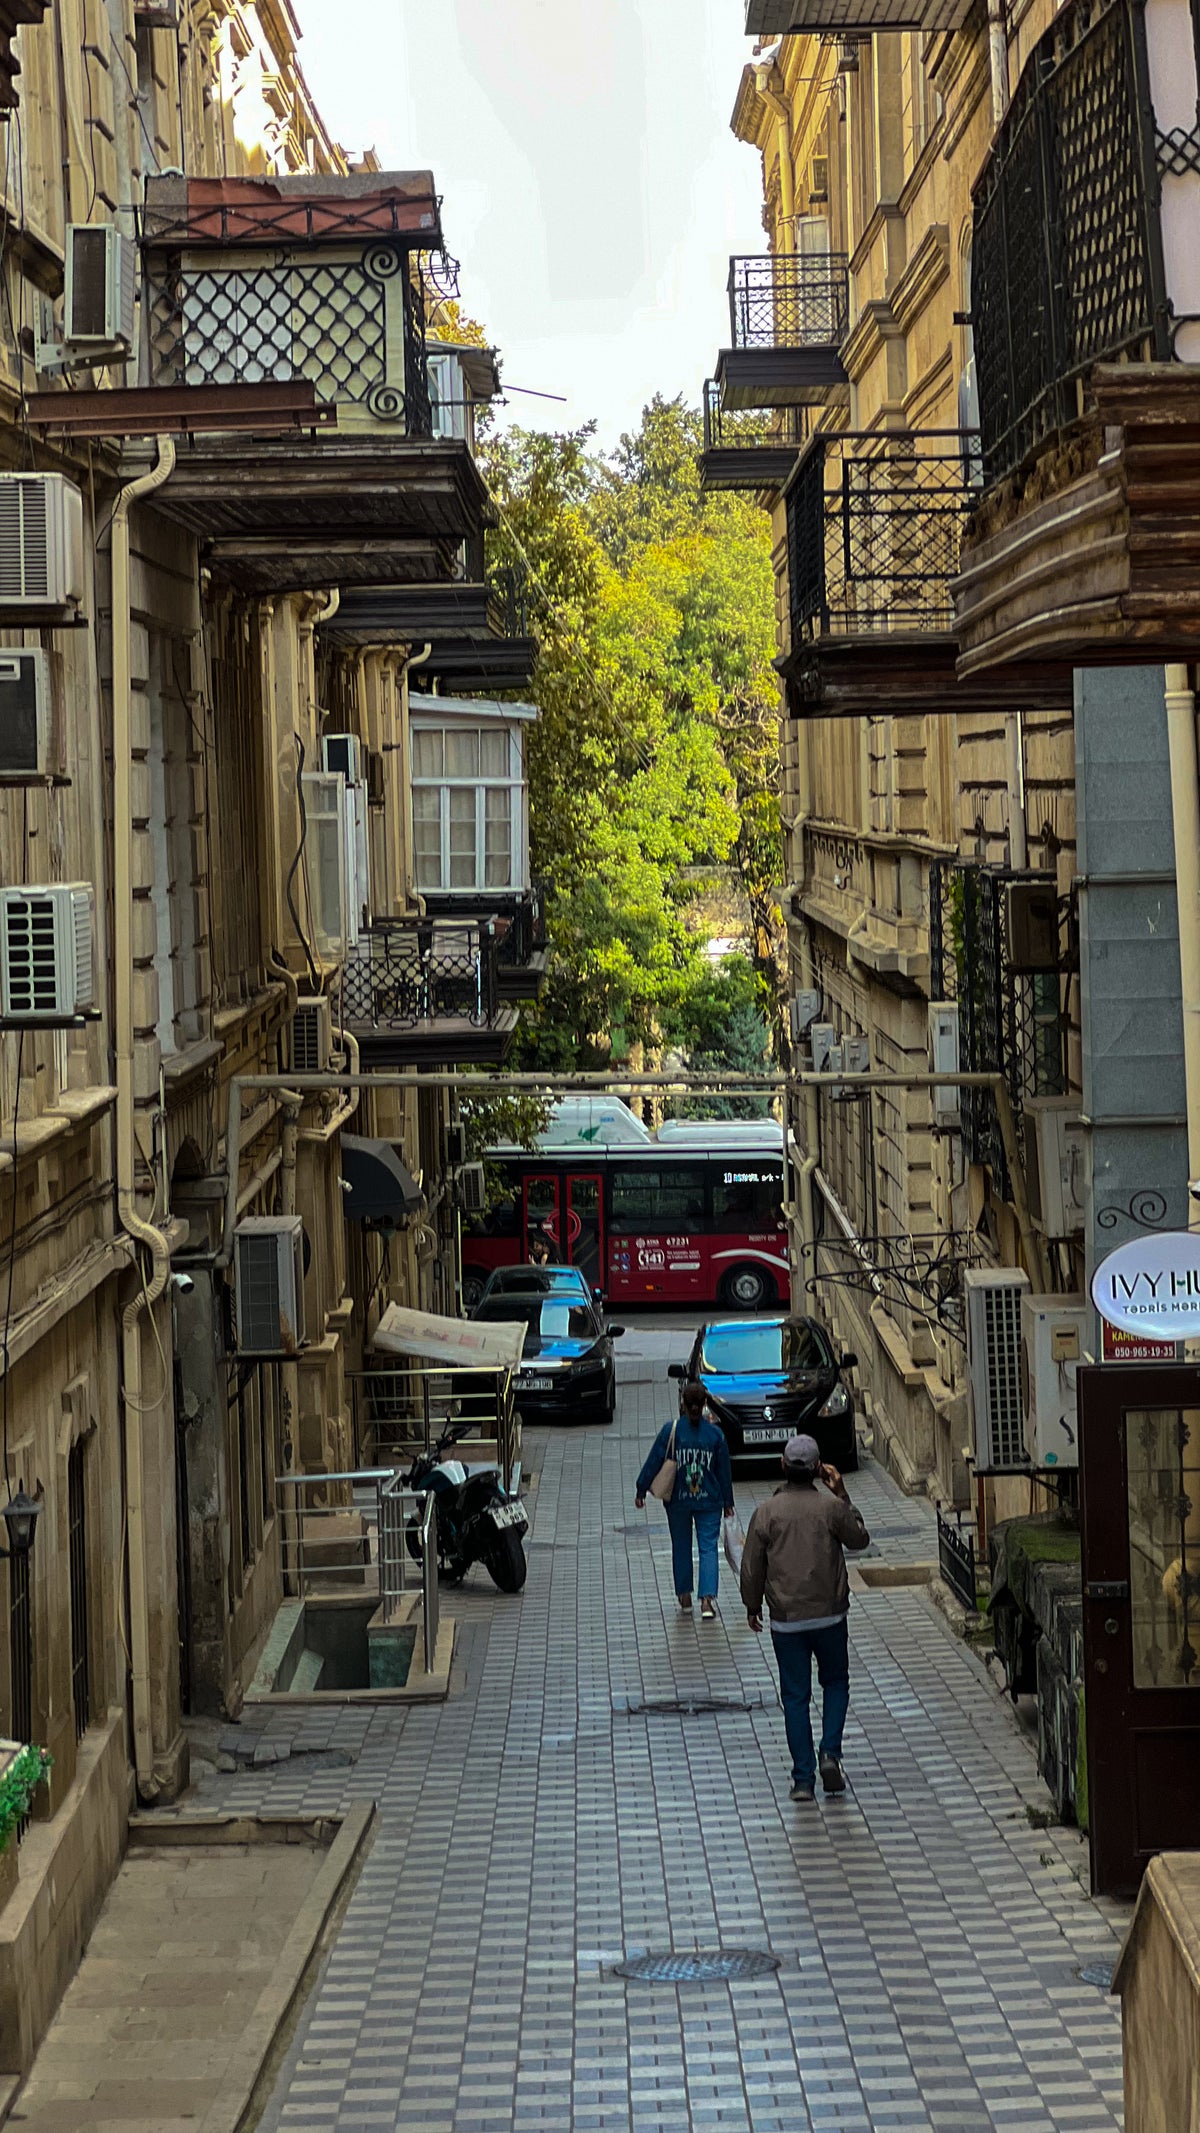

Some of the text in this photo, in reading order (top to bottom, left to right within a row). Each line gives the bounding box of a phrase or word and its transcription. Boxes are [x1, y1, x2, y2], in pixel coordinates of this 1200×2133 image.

[644, 1252, 662, 1264] 141
[1110, 1271, 1163, 1300] IVY
[1122, 1300, 1200, 1315] TƏDRİS MƏR
[675, 1448, 713, 1471] MICKEY
